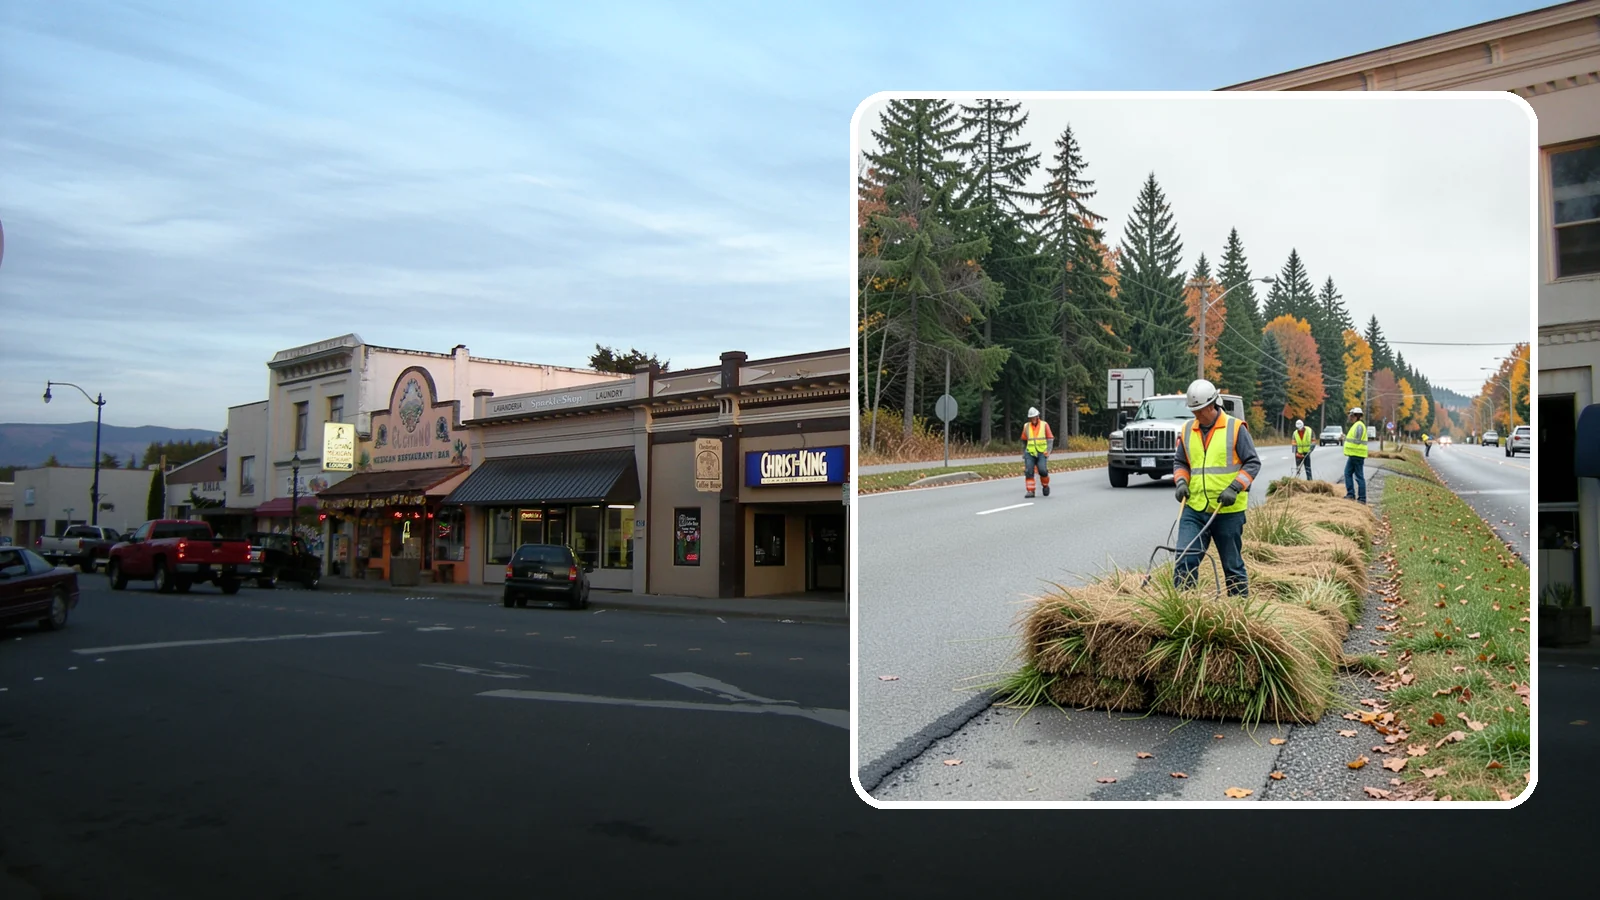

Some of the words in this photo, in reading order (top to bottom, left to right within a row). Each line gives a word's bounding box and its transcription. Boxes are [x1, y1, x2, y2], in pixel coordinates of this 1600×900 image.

[494, 402, 523, 412] LAVANDERIA
[562, 394, 582, 406] Shop
[595, 389, 624, 400] LAUNDRY
[374, 454, 396, 464] MEXICAN
[397, 451, 434, 462] RESTAURANT
[437, 450, 450, 459] BAR
[761, 452, 797, 477] CHRIST
[799, 450, 828, 476] KING
